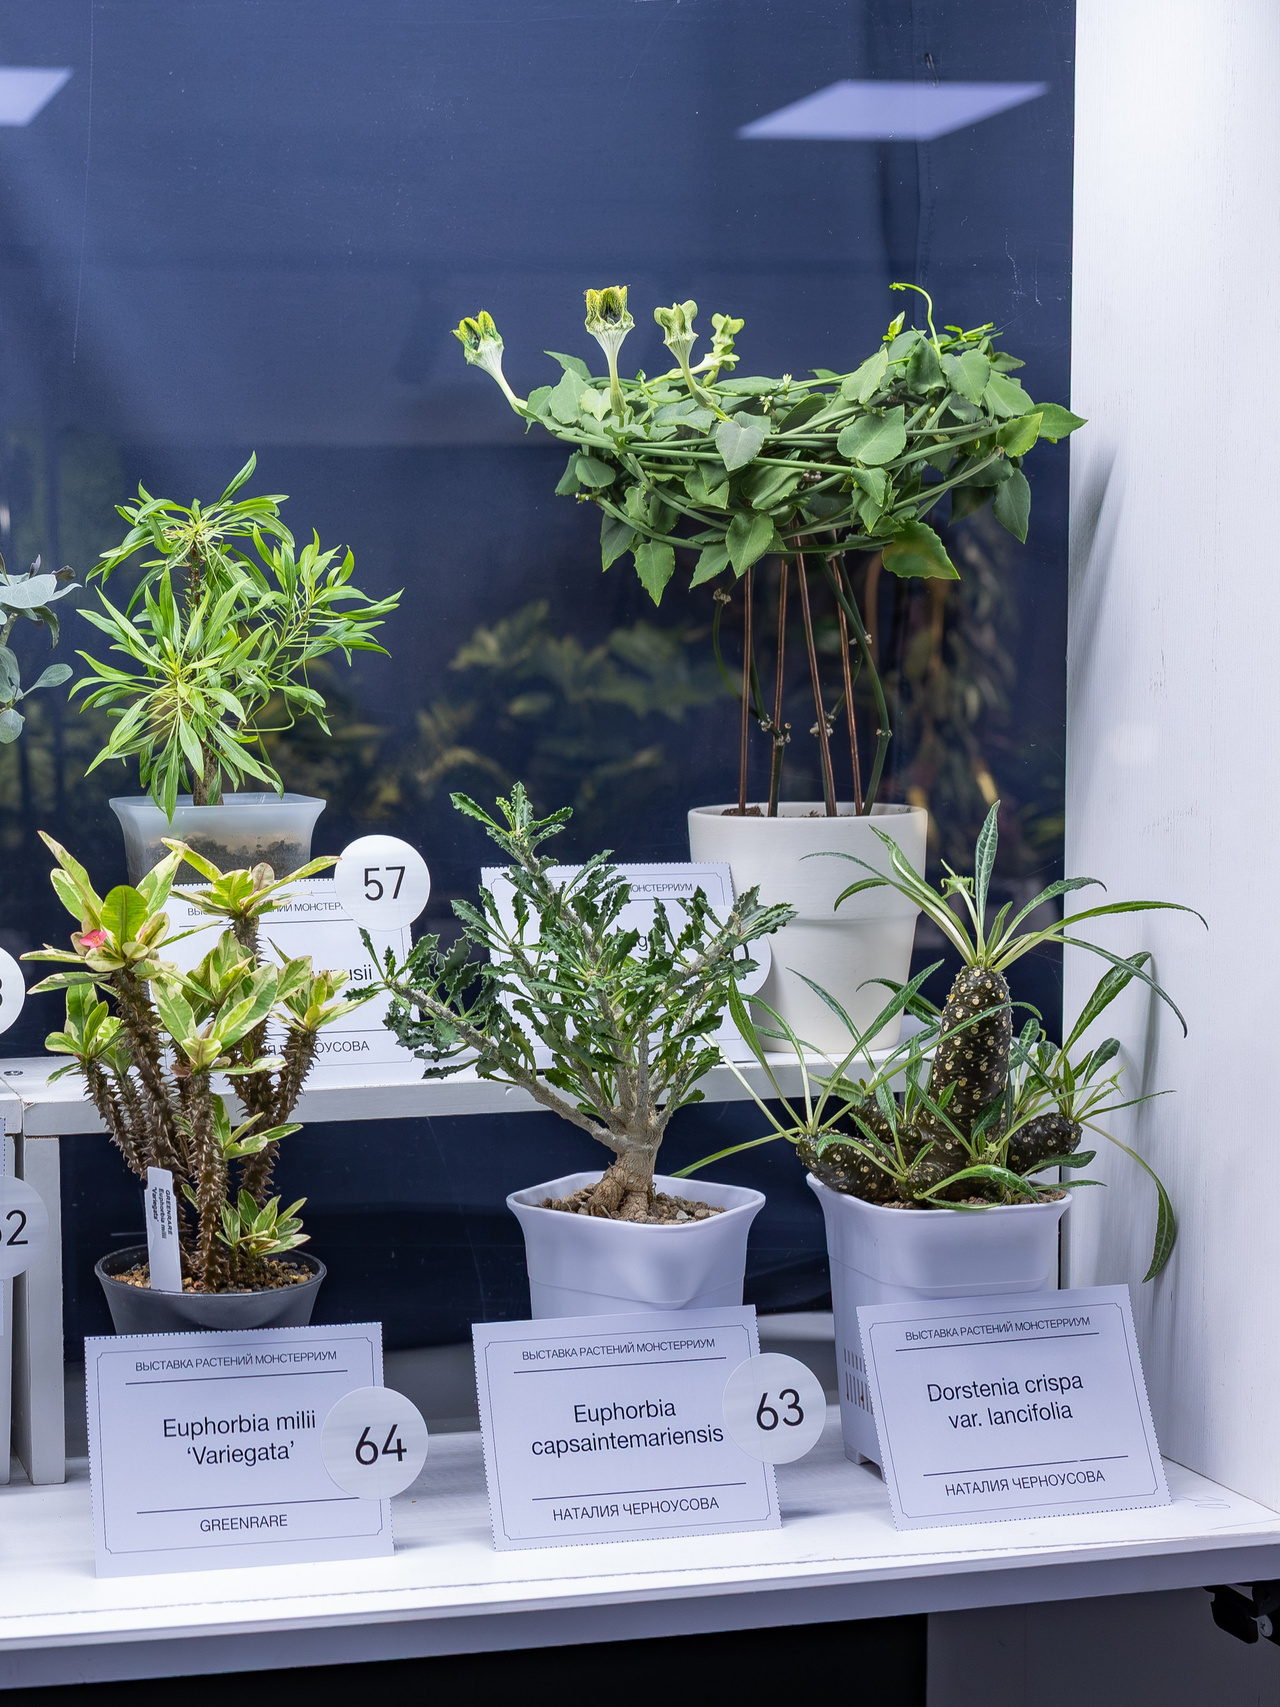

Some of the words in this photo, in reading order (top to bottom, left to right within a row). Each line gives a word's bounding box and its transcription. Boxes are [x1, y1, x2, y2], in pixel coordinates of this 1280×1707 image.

[363, 866, 406, 901] 57
[629, 883, 693, 893] ОНСТЕРРИУМ
[294, 902, 343, 912] МОНСТЕР
[905, 1328, 959, 1342] ВЫСТАВКА
[960, 1321, 1014, 1337] РАСТЕНИЙ
[1015, 1317, 1091, 1332] МОНСТЕРРИУМ
[135, 1359, 194, 1372] ВЫСТАВКА
[195, 1353, 252, 1369] РАСТЕНИЙ
[255, 1351, 337, 1365] МОНСТЕРРИУМ
[522, 1348, 578, 1361] ВЫСТАВКА
[579, 1342, 635, 1357] РАСТЕНИЙ
[636, 1338, 715, 1353] МОНСТЕРРИУМ
[927, 1378, 1020, 1403] Dorstenia
[1025, 1373, 1084, 1396] crispa
[574, 1399, 676, 1425] Euphorbia
[756, 1388, 805, 1431] 63
[948, 1412, 983, 1429] var.
[987, 1401, 1073, 1427] lancifolia
[163, 1414, 269, 1440] Euphorbia
[276, 1410, 316, 1430] milii
[187, 1441, 295, 1467] ‘Variegata’
[355, 1424, 407, 1465] 64
[531, 1425, 724, 1458] capsaintemariensis
[945, 1478, 1010, 1497] НАТАЛИЯ
[1012, 1470, 1106, 1490] ЧЕРНОУСОВА
[553, 1505, 620, 1522] НАТАЛИЯ
[623, 1497, 720, 1516] ЧЕРНОУСОВА
[200, 1514, 288, 1532] GREENRARE
